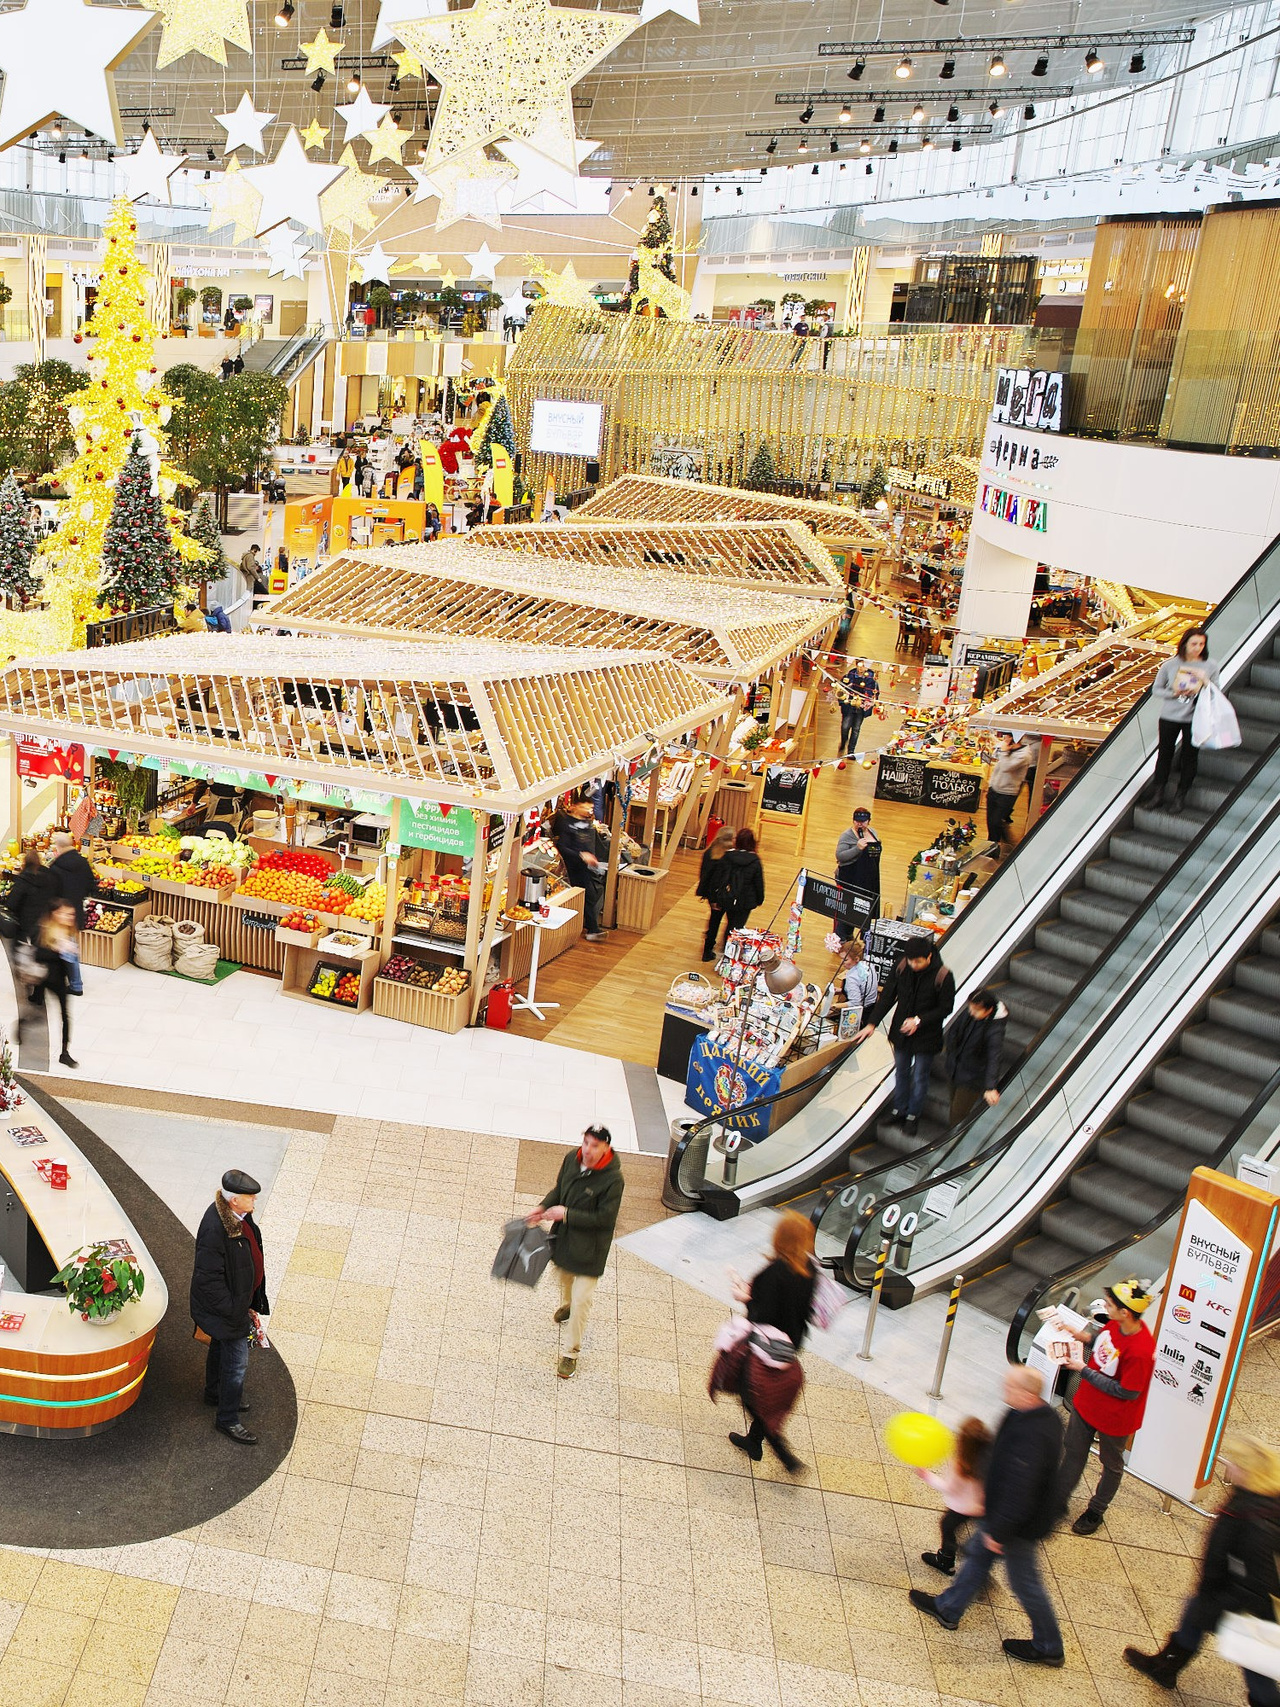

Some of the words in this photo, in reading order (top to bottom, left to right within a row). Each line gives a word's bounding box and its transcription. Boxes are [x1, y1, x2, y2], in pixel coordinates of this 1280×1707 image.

[423, 802, 459, 815] фруы
[411, 821, 460, 836] пестицидов
[415, 833, 465, 847] гербицидов
[1190, 1234, 1241, 1264] ВКУСНЫЙ
[1187, 1247, 1237, 1275] БУЛЬВАР
[1206, 1300, 1232, 1317] KFC
[1174, 1312, 1191, 1321] KING
